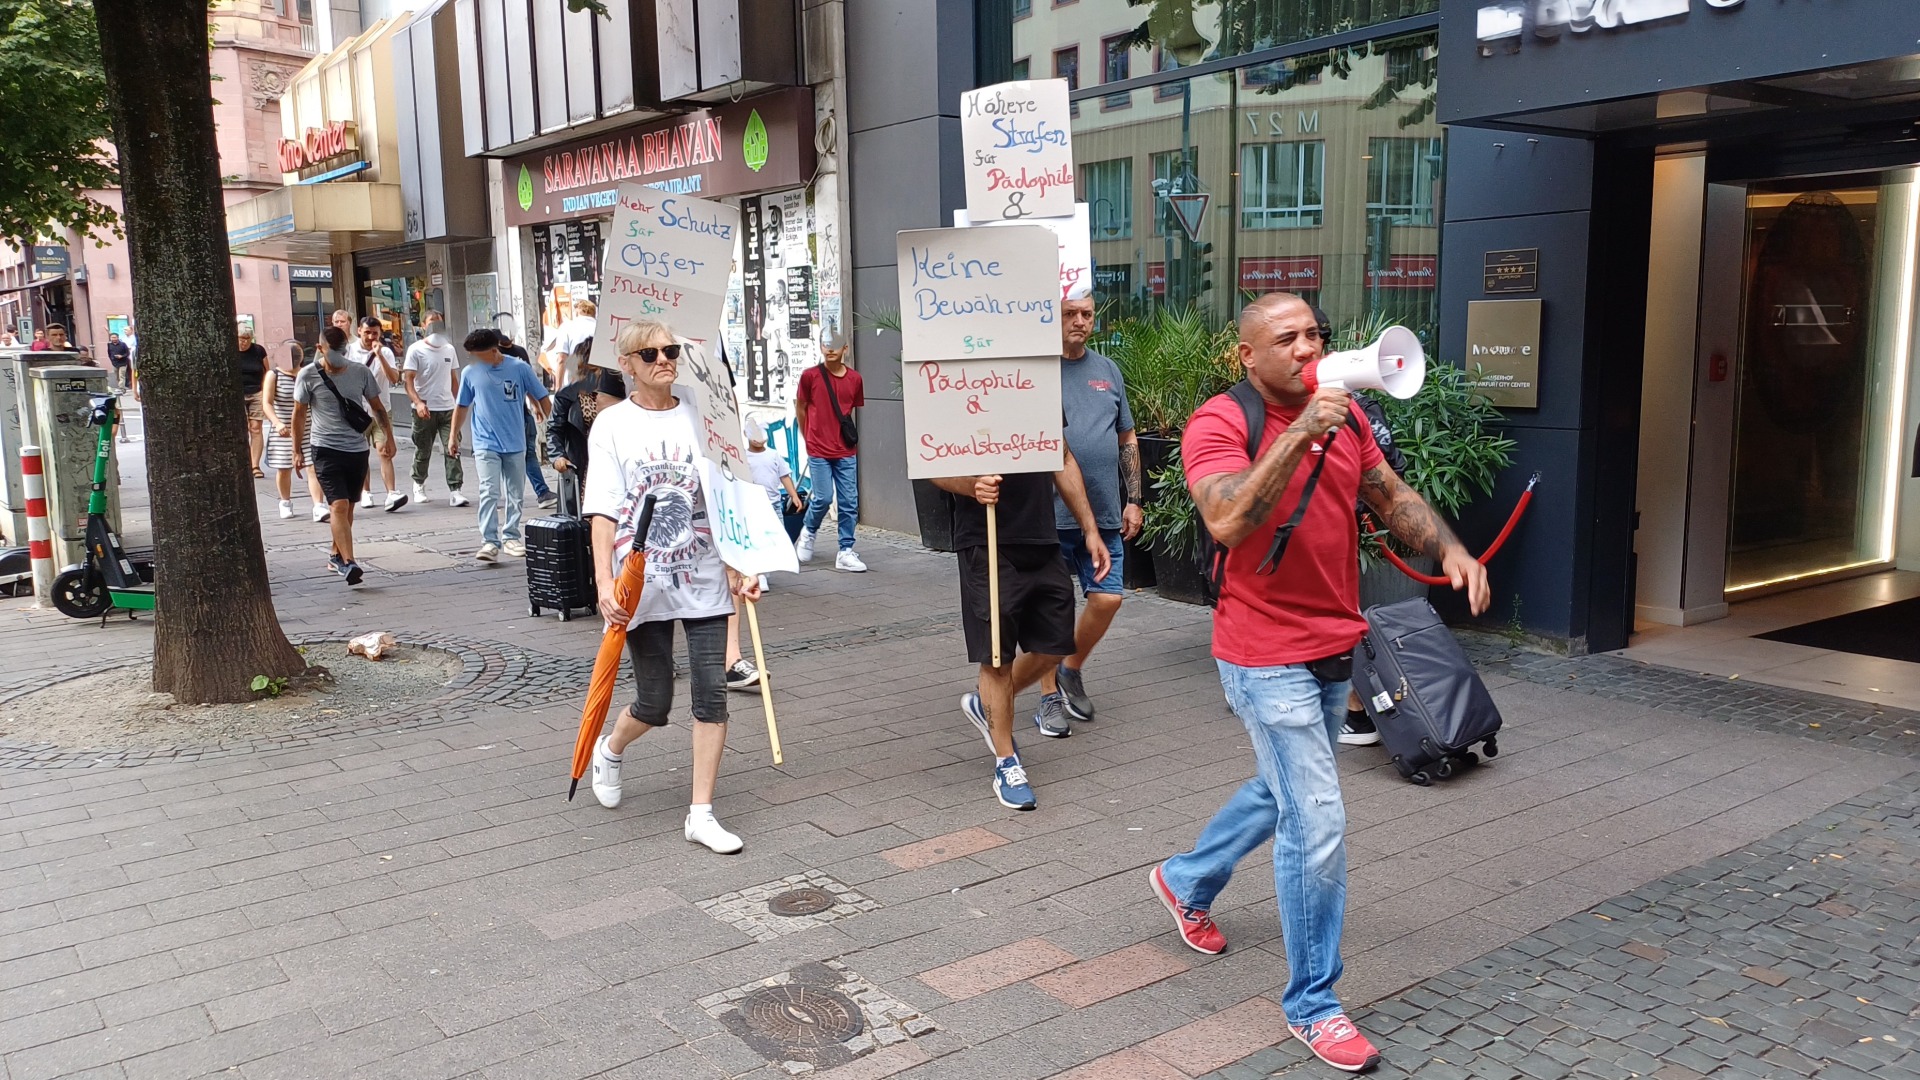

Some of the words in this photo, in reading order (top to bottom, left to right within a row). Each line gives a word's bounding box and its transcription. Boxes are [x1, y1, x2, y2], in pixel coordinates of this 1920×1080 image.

[276, 137, 303, 173] Kino
[304, 120, 347, 163] Center
[992, 118, 1068, 153] Strafen
[543, 136, 641, 194] SARAVANAA
[641, 116, 722, 175] BHAVAN
[562, 193, 590, 213] INDIAN
[590, 188, 619, 208] VEGET
[643, 174, 703, 194] STAURANT
[986, 163, 1074, 198] Pädophile
[618, 195, 656, 214] Mehr
[658, 199, 732, 240] Schutz
[1002, 191, 1033, 220] &
[293, 268, 319, 278] ASIAN
[320, 270, 333, 279] FO
[621, 243, 705, 278] Opfer
[911, 246, 1003, 287] Keine
[914, 288, 1054, 323] Bewährung
[962, 335, 994, 354] für
[919, 361, 1035, 396] Pädophile
[99, 439, 110, 458] Bolt
[920, 430, 1060, 462] Sexualstraftäter
[713, 488, 778, 550] Kind
